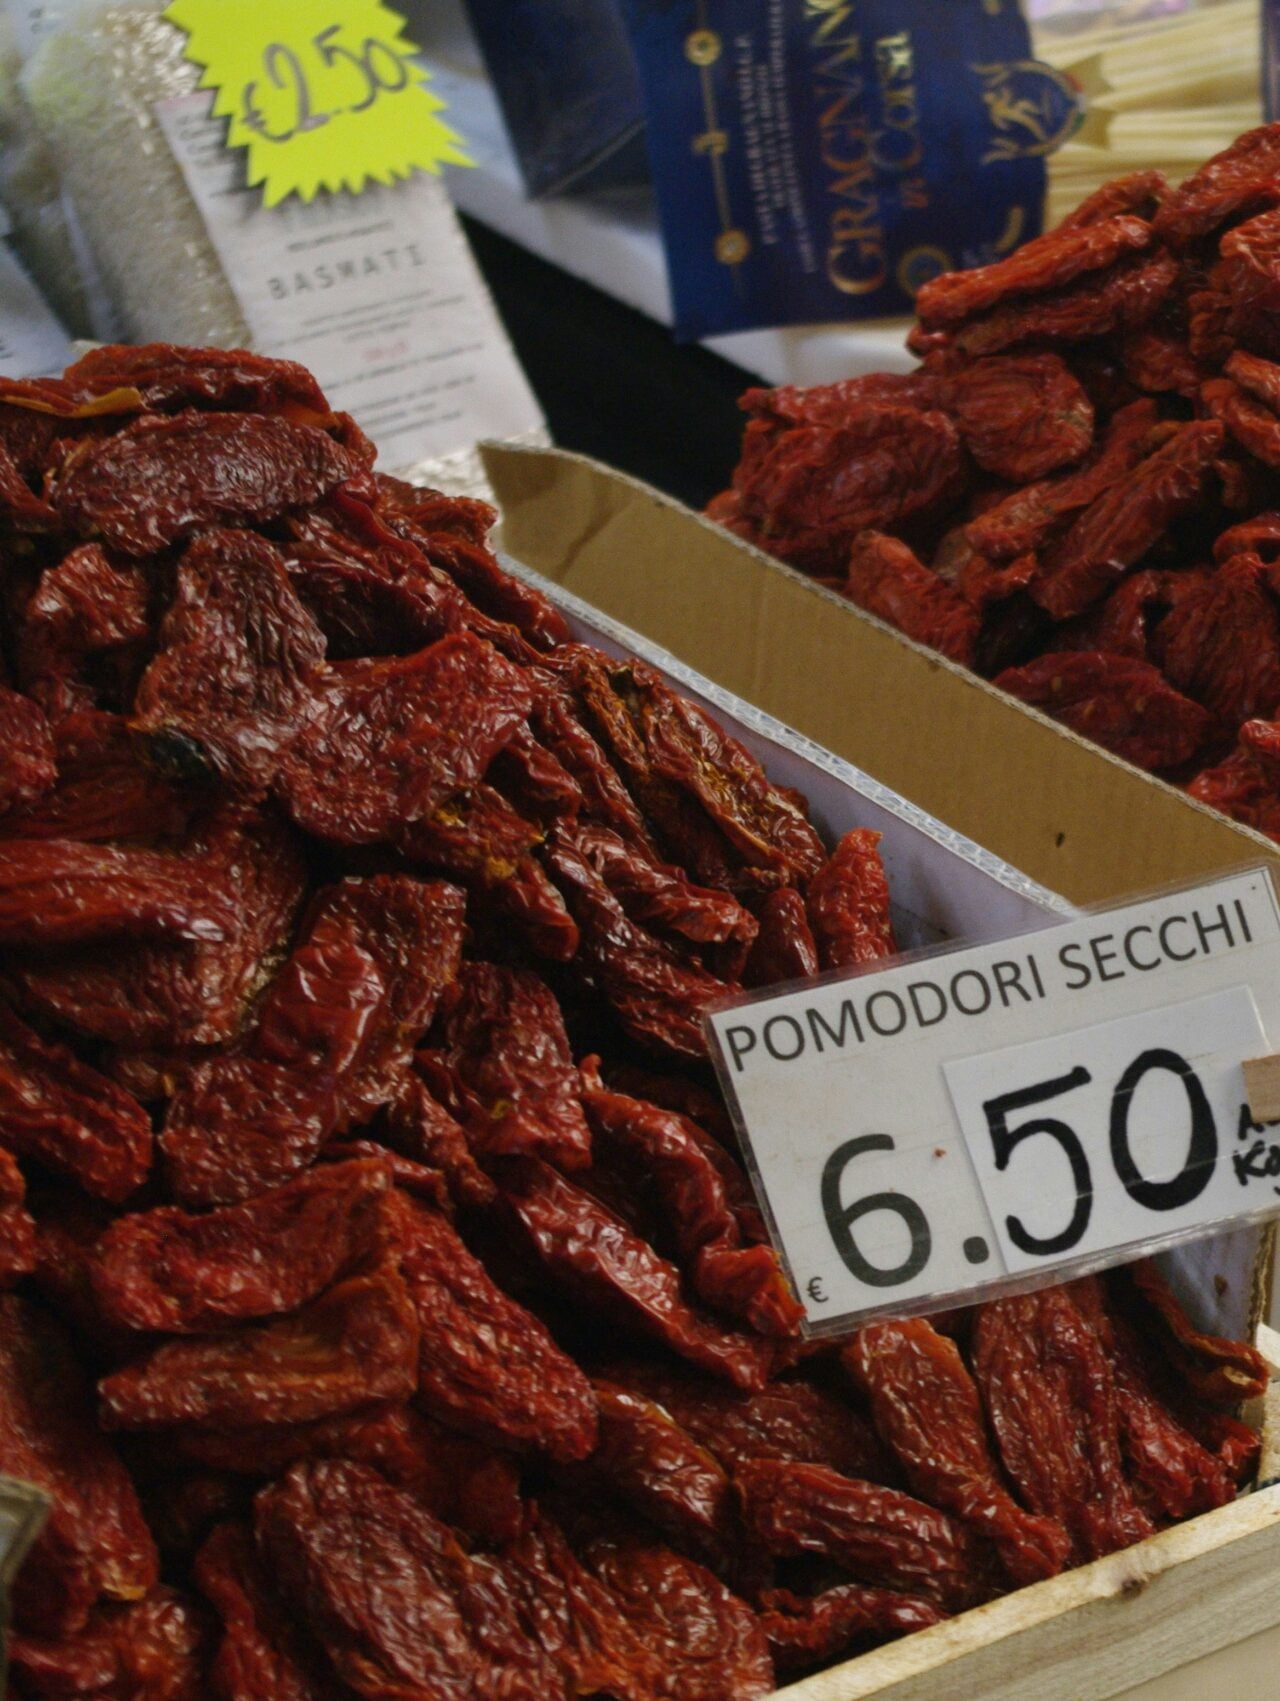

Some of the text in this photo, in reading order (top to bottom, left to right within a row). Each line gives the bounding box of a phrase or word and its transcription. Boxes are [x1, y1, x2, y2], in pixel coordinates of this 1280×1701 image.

[804, 0, 886, 295] GRAGNAN
[724, 897, 1254, 1073] POMODORI SECCHI
[820, 1047, 1219, 1288] 6.50
